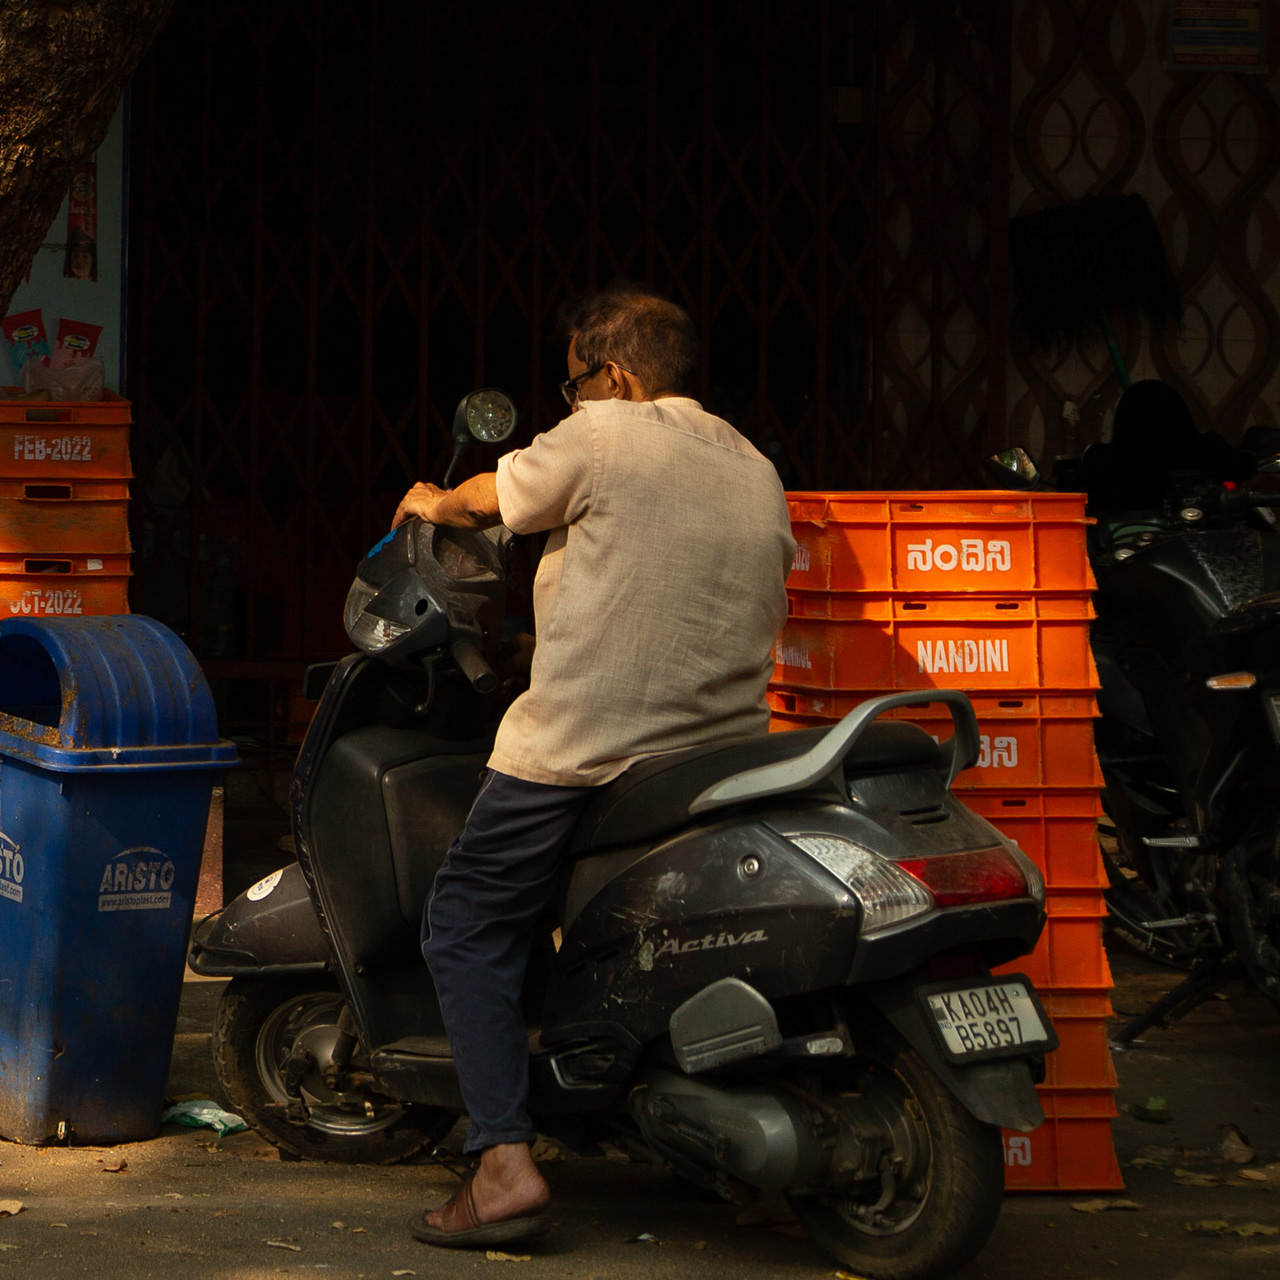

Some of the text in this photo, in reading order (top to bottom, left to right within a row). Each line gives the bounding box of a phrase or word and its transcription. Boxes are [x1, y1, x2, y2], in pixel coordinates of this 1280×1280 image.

[13, 434, 93, 462] FEB-2022
[907, 537, 1012, 573] ನಂದಿನಿ
[916, 638, 1010, 674] NANDINI
[98, 858, 177, 893] ARISTO
[100, 893, 171, 910] www.aristoplast.com
[653, 926, 769, 961] Activa
[941, 986, 1015, 1022] KA04H
[954, 1016, 1024, 1054] B5897
